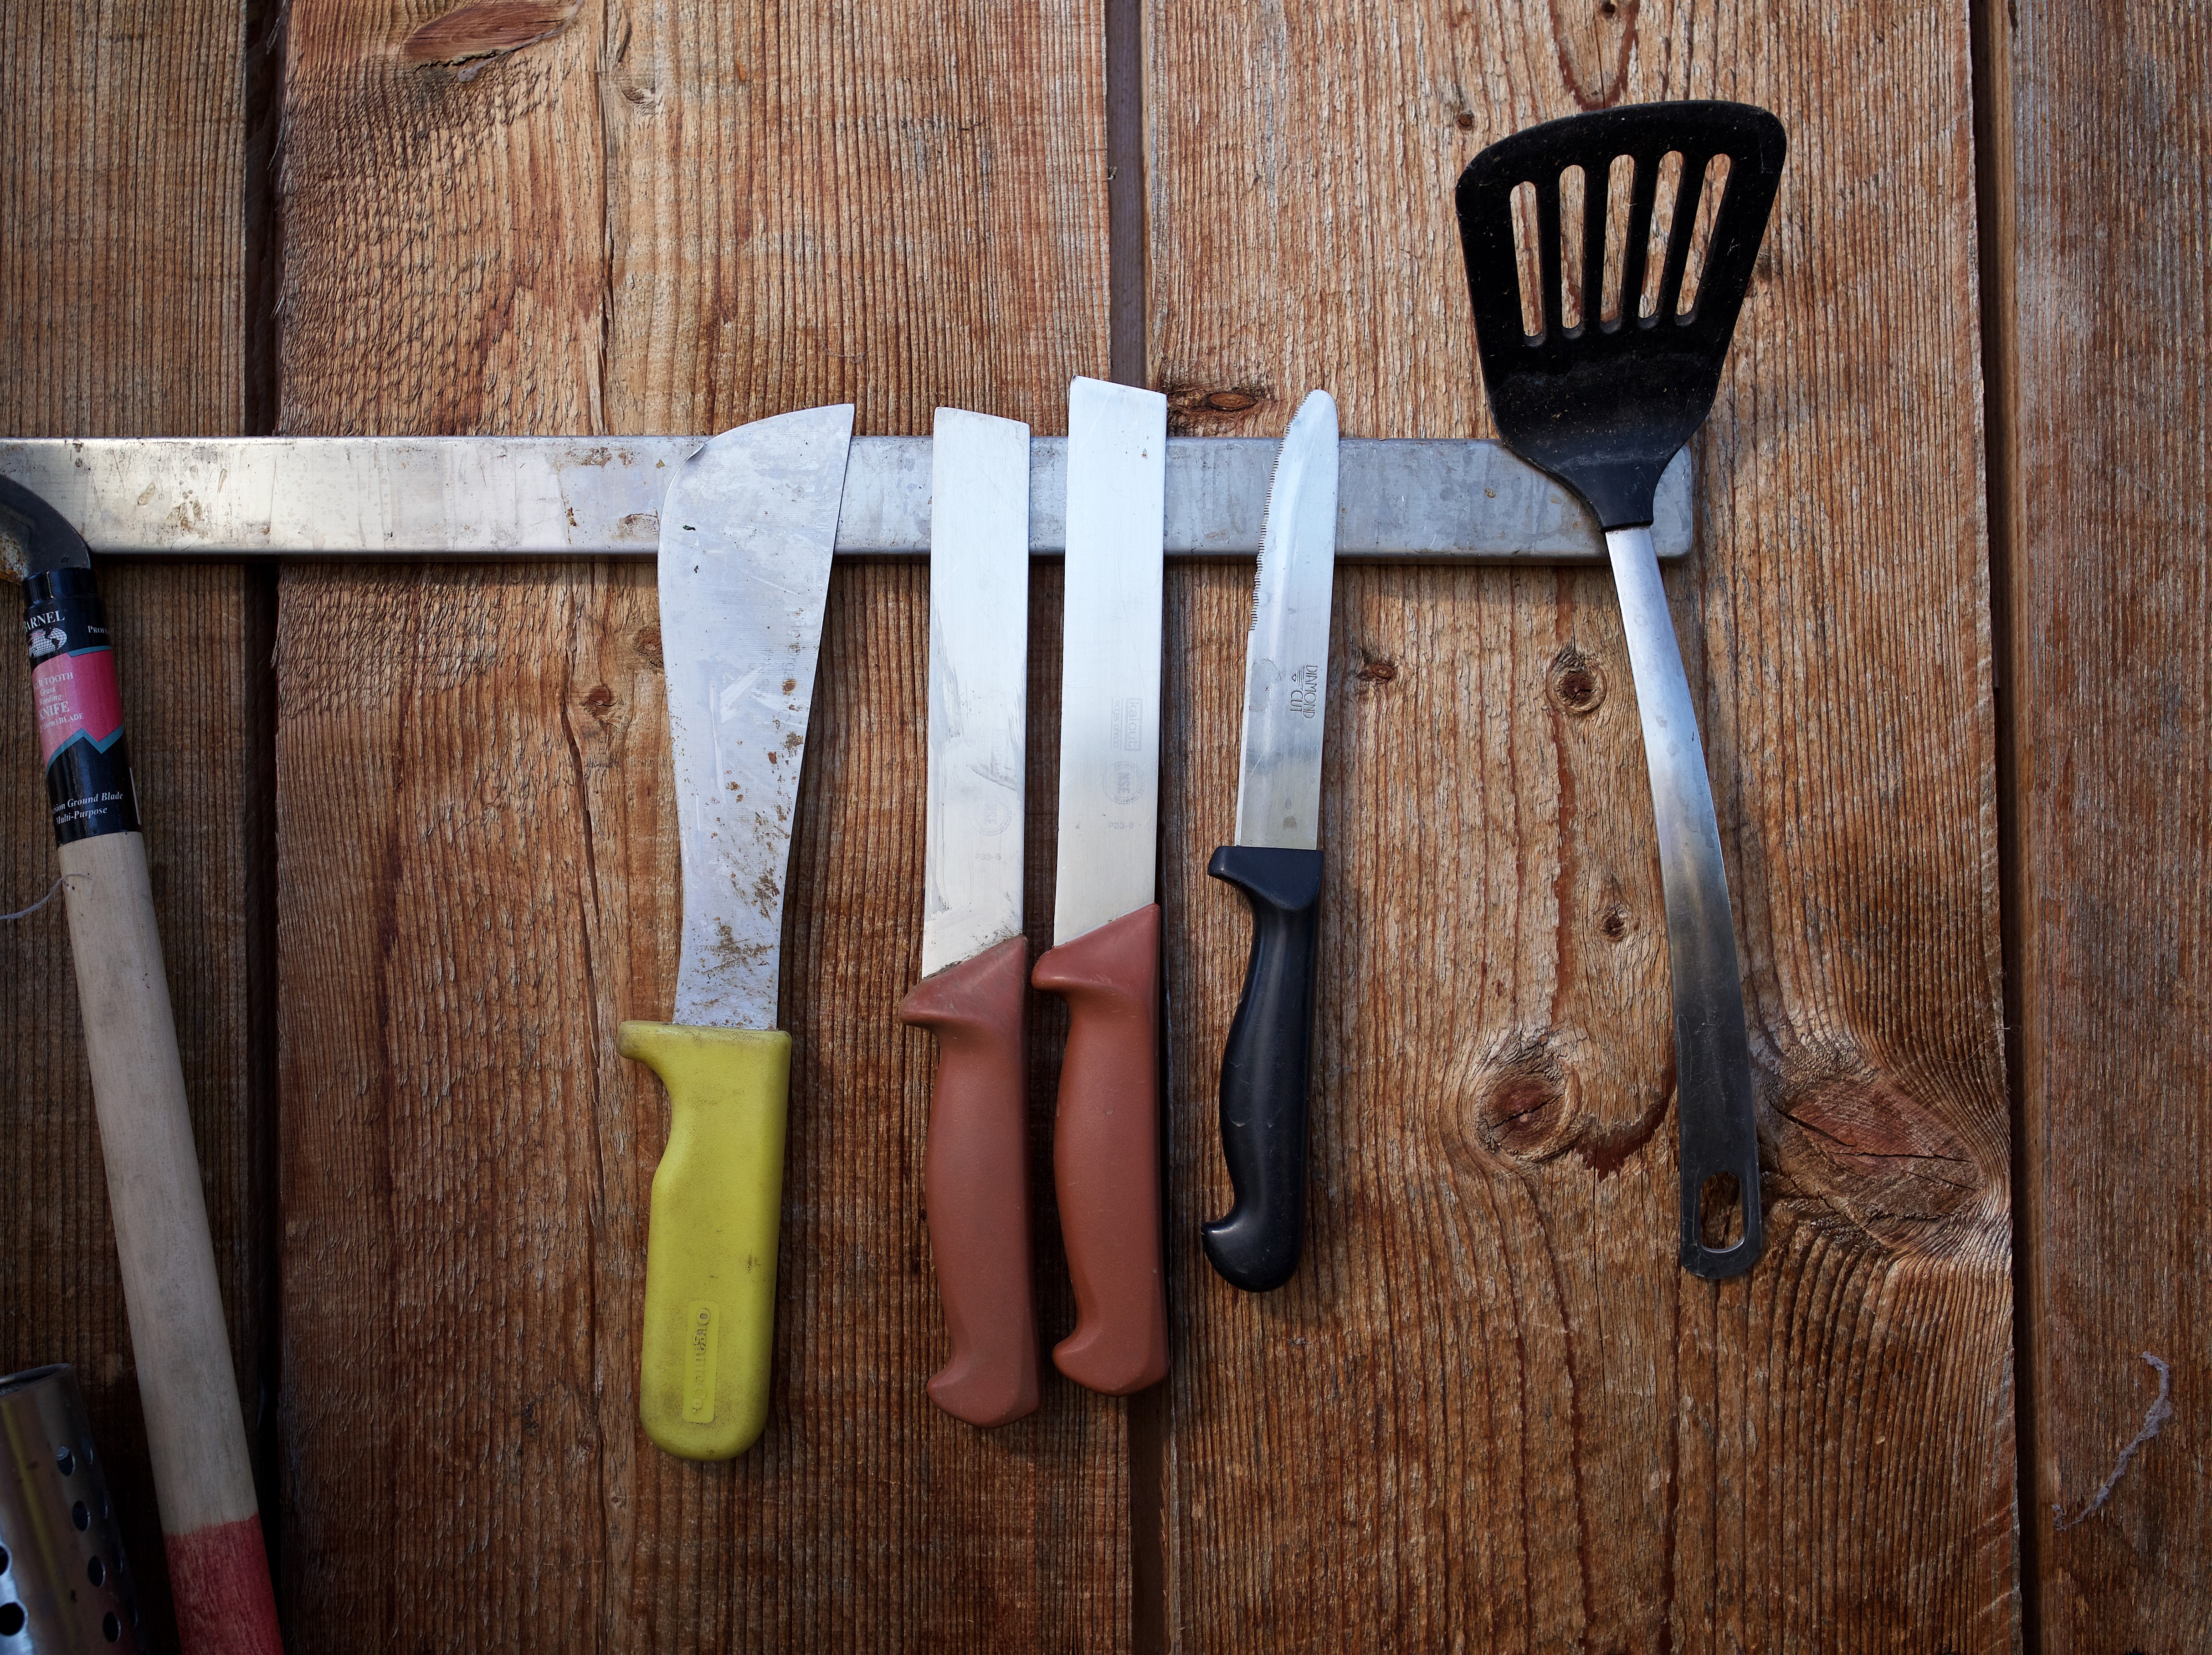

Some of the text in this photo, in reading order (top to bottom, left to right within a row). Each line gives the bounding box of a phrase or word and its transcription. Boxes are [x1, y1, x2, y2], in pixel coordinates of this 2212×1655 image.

[44, 672, 73, 685] TOOTH
[40, 687, 56, 697] Grass
[1303, 666, 1318, 718] DIAMOND
[39, 701, 69, 721] KNIFE
[1290, 691, 1303, 714] CUT
[59, 713, 84, 724] BLADE
[67, 794, 98, 807] Ground
[102, 791, 123, 801] Blade
[56, 807, 108, 825] Multi-Purpose
[692, 1307, 711, 1414] Organic Co.
